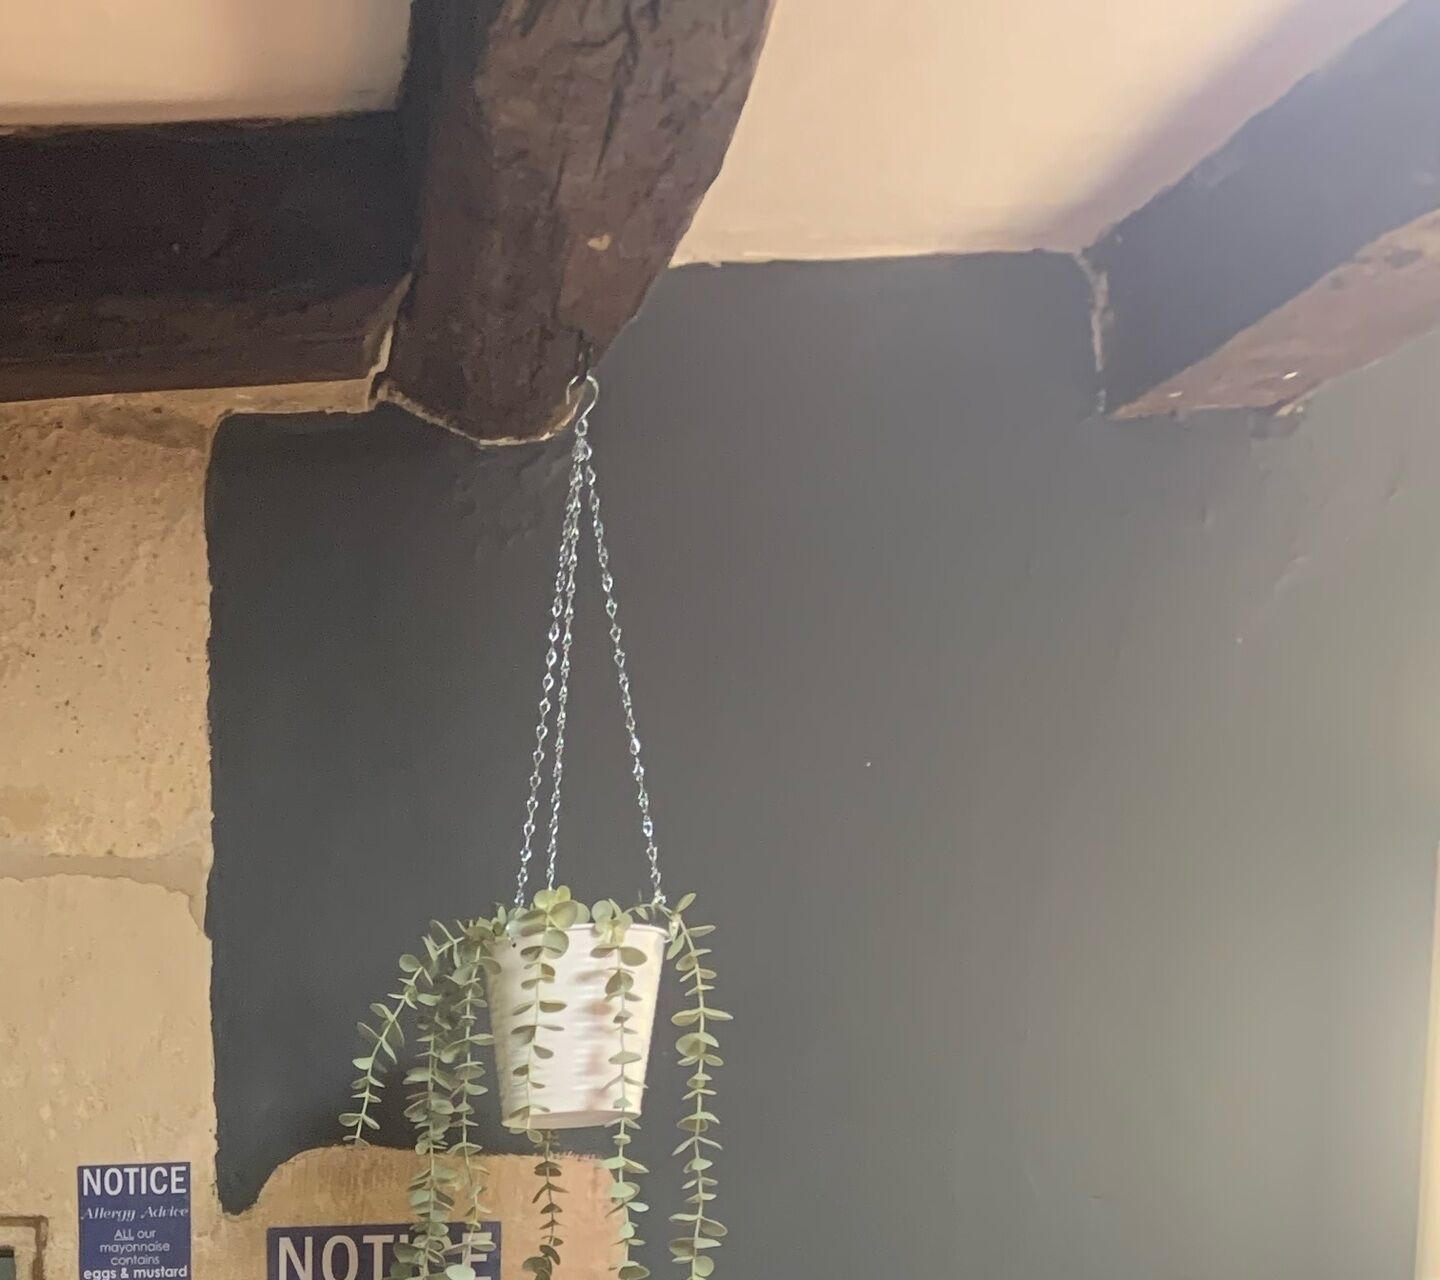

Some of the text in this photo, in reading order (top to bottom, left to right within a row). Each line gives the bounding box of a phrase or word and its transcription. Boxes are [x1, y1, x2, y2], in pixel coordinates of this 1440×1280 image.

[82, 1166, 187, 1196] NOTICE
[80, 1205, 189, 1222] Allergy Advice
[113, 1229, 156, 1241] ALL our
[99, 1241, 170, 1255] mayonnaise
[110, 1254, 160, 1266] contains
[120, 1267, 129, 1279] &
[133, 1265, 188, 1278] mustard
